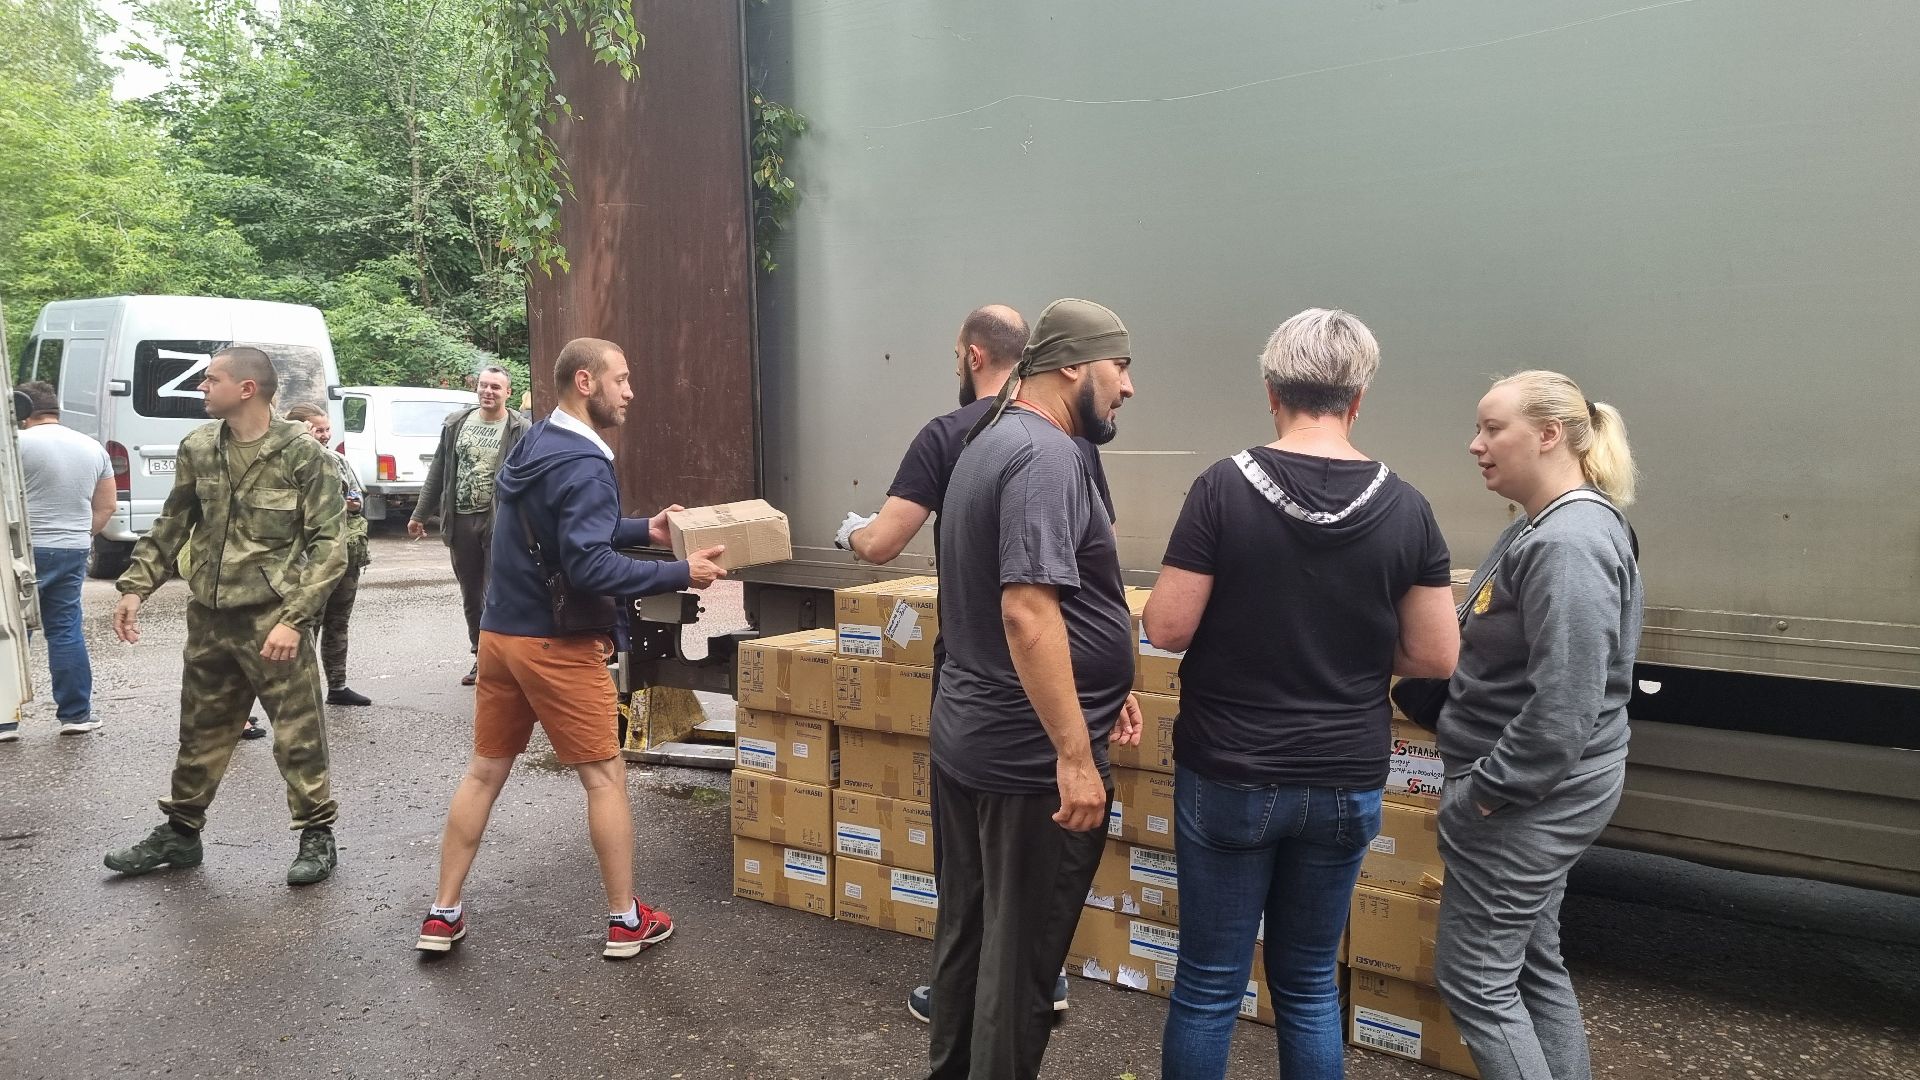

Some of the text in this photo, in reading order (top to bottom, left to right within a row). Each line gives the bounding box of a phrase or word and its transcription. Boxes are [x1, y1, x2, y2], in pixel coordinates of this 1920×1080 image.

[158, 348, 211, 399] Z
[1408, 745, 1442, 759] СТАЛЬК
[1356, 956, 1402, 972] AsahiKASEI
